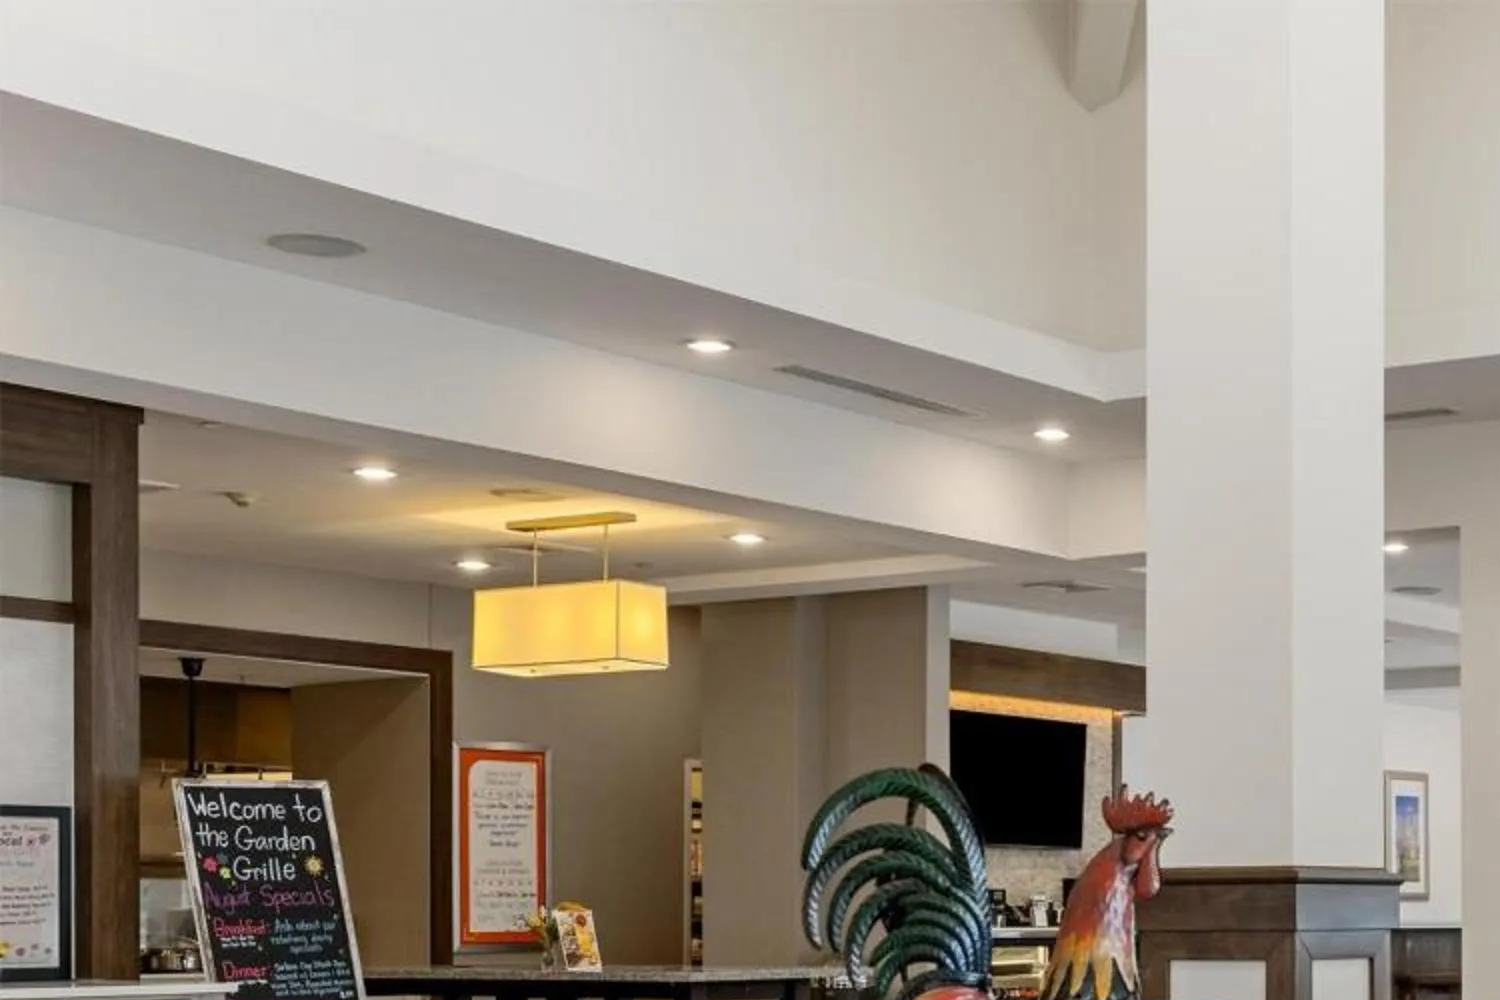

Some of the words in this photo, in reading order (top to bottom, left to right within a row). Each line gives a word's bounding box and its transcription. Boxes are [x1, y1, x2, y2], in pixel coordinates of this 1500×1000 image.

[187, 792, 287, 822] Welcome
[292, 793, 323, 823] to
[196, 823, 229, 848] the
[234, 825, 316, 851] Garden
[232, 855, 296, 881] Grille
[259, 880, 335, 914] Specials
